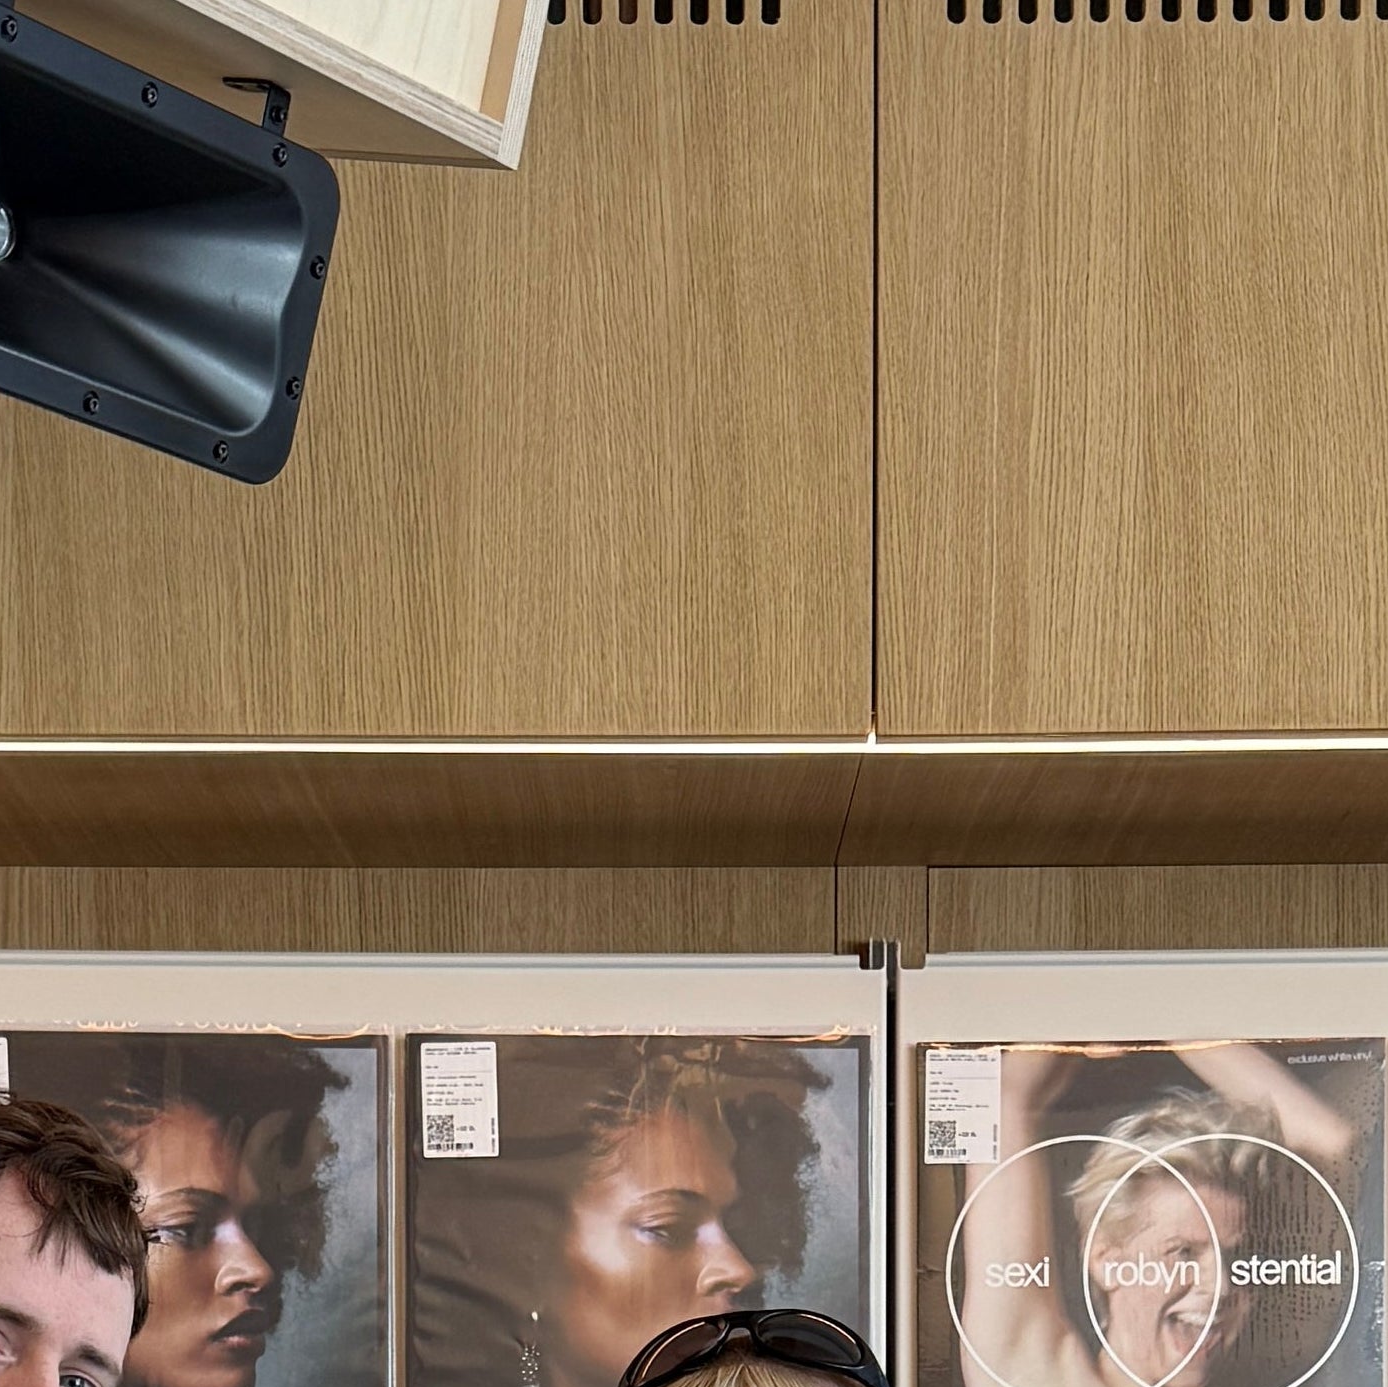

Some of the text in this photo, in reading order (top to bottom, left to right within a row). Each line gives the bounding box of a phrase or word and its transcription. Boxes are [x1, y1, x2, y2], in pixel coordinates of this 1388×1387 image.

[985, 1250, 1342, 1294] sexi robyn stential
